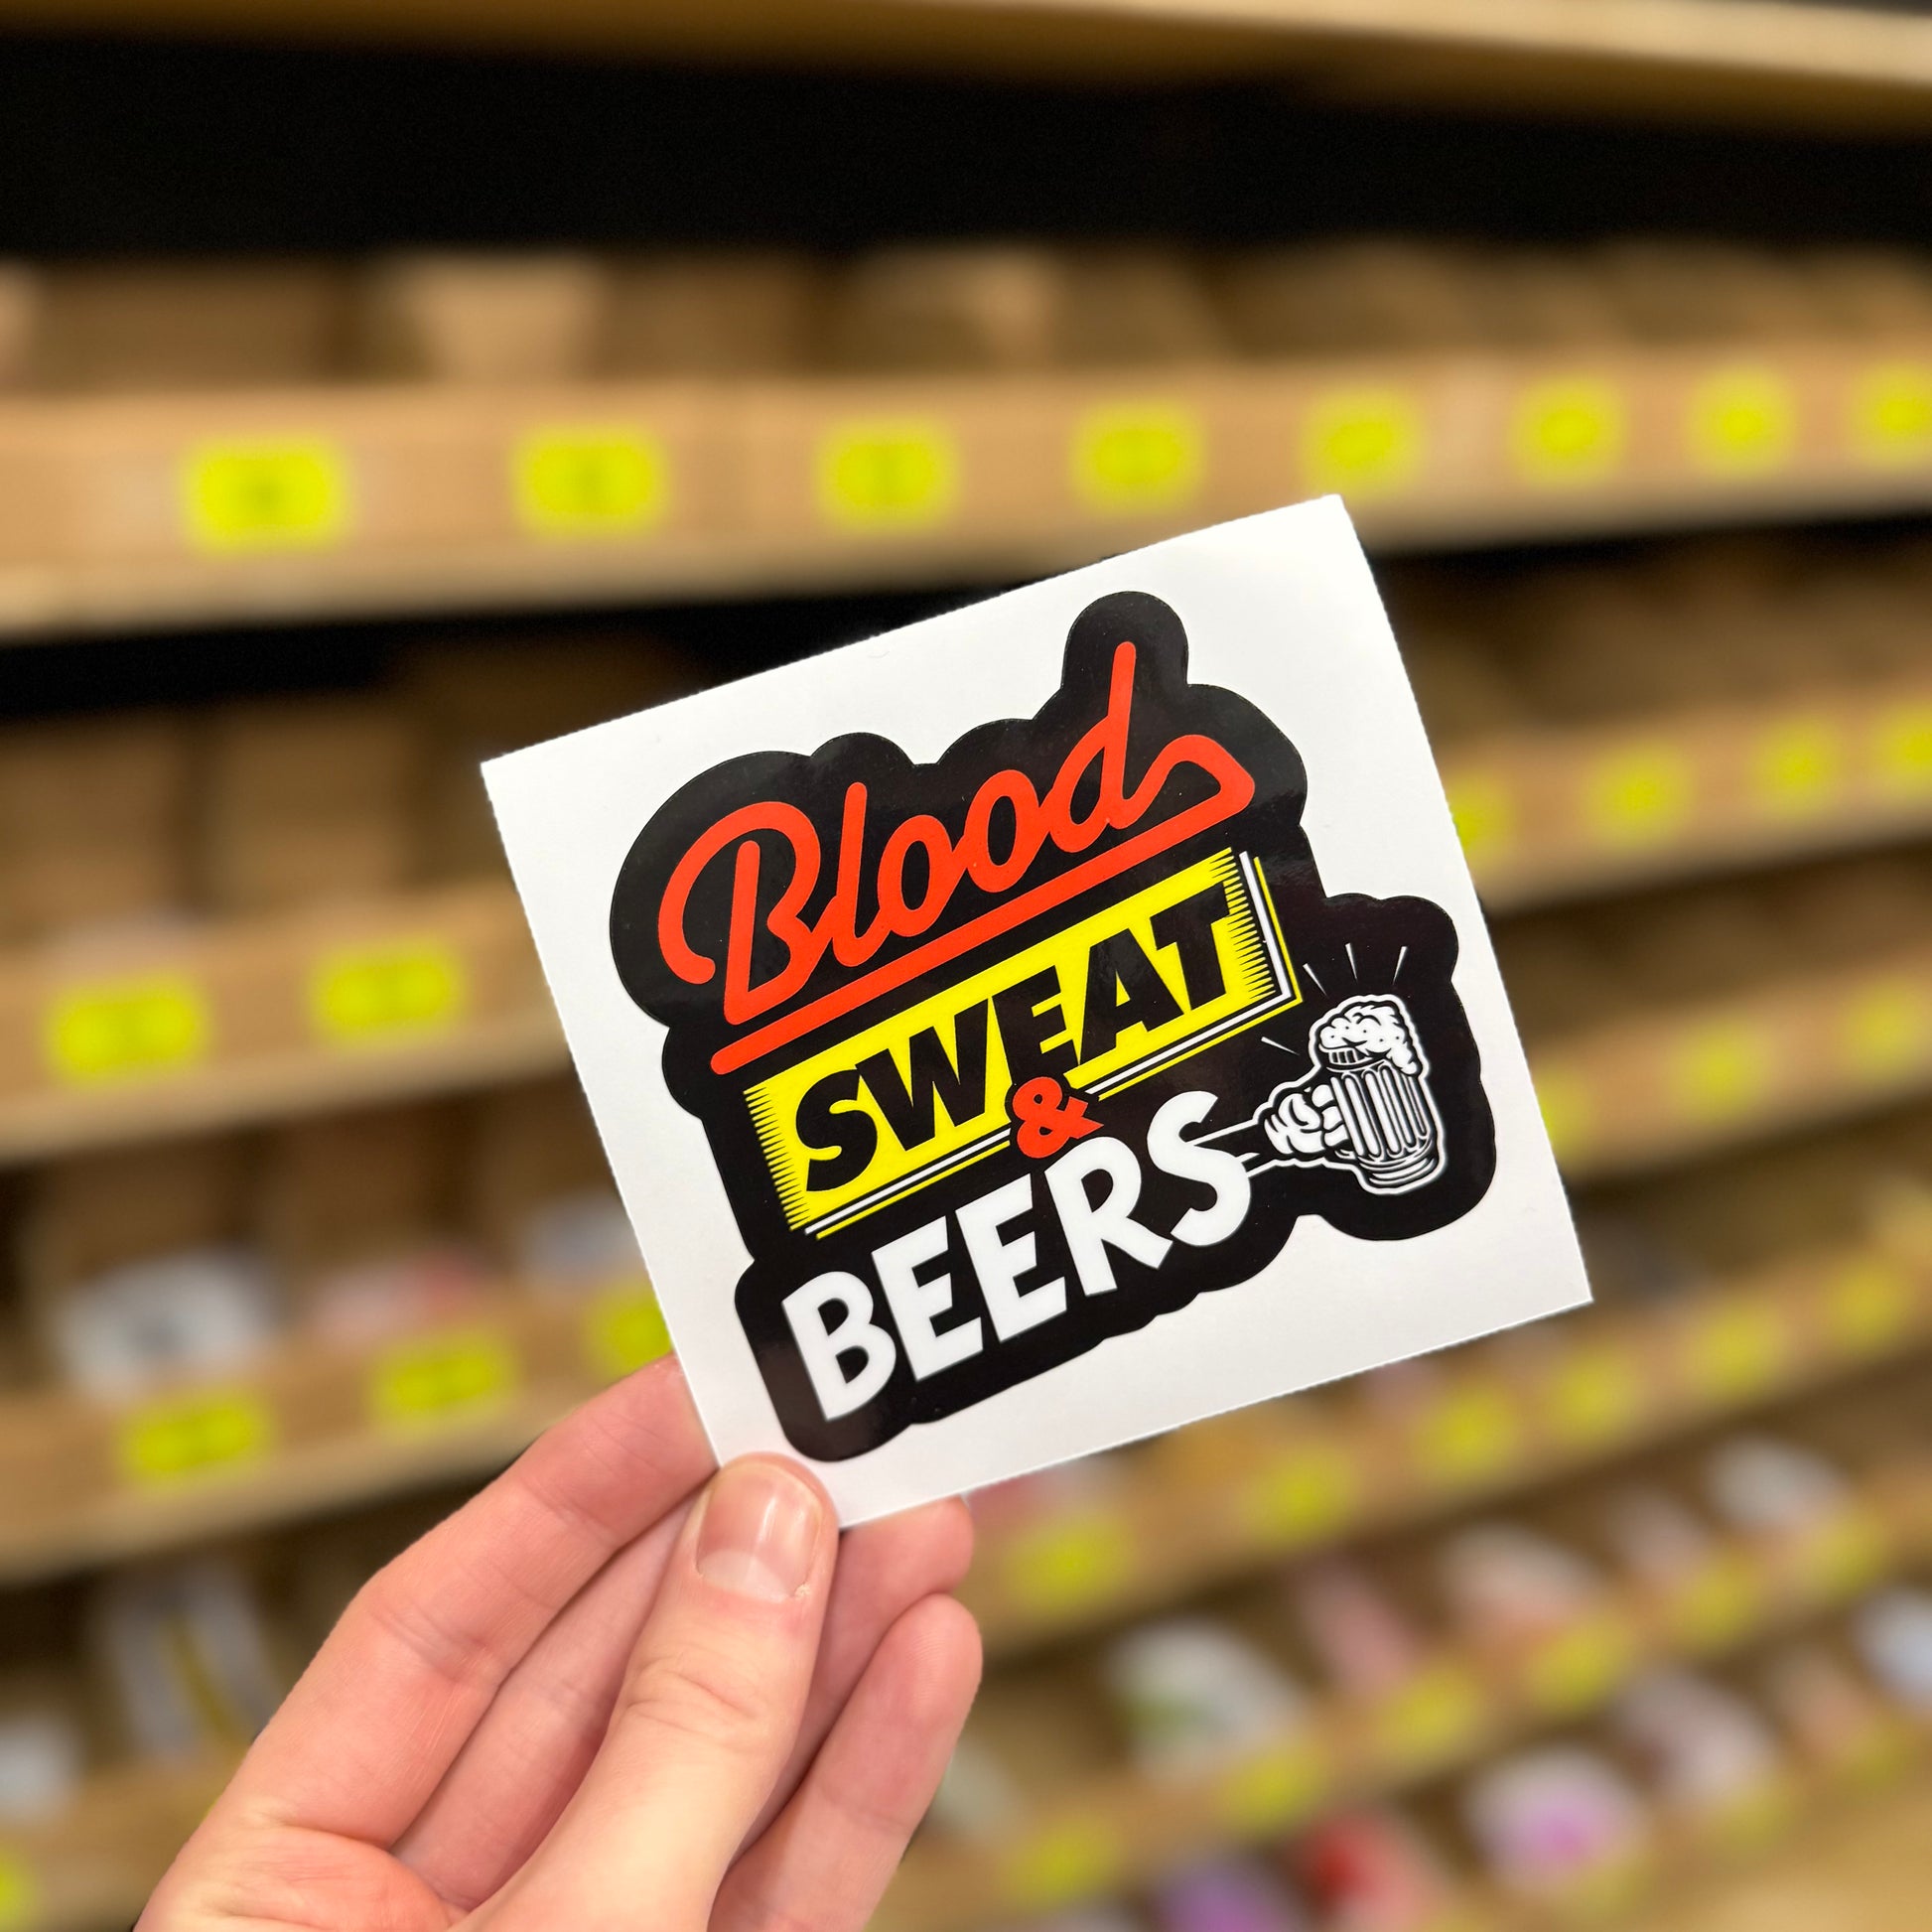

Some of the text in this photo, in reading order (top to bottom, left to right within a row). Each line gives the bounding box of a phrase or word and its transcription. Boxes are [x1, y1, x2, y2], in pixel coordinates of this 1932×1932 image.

[657, 640, 1256, 1075] Blood
[793, 885, 1237, 1192] SWEAT
[1011, 1076, 1104, 1159] &
[780, 1089, 1252, 1422] BEERS
